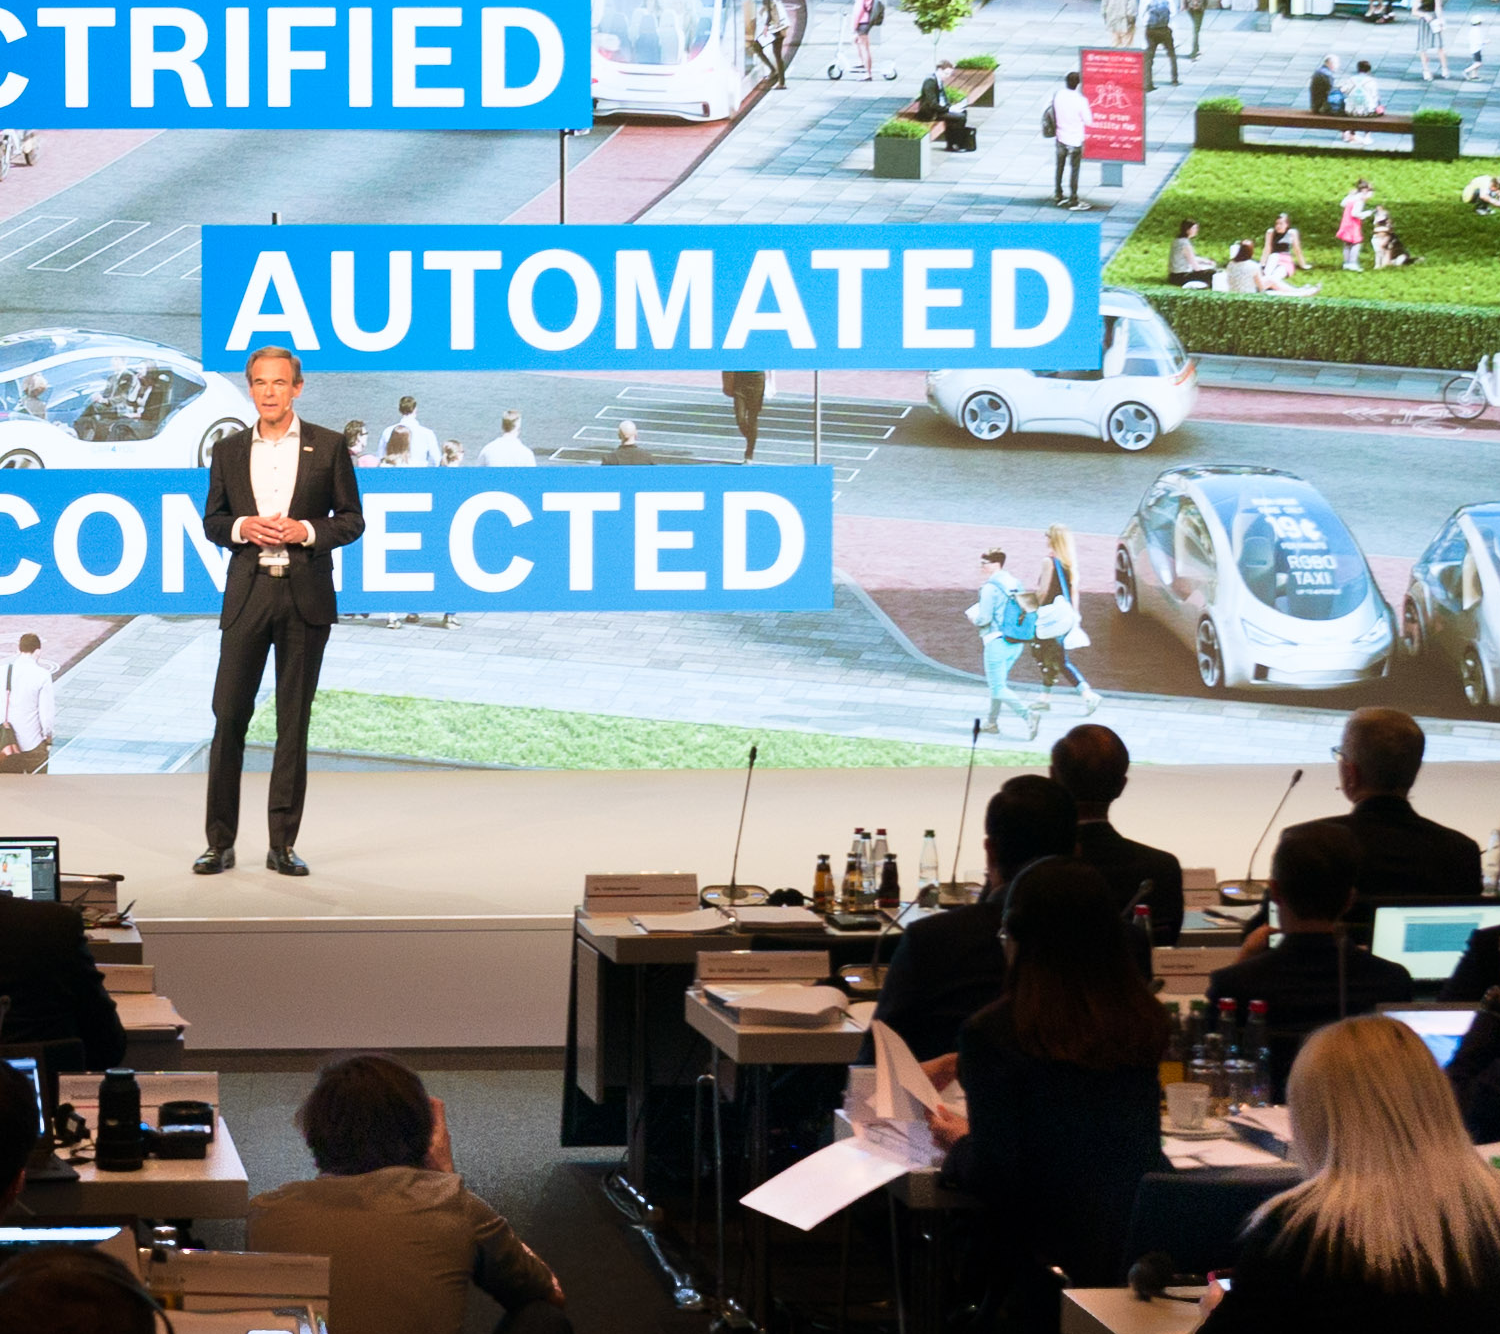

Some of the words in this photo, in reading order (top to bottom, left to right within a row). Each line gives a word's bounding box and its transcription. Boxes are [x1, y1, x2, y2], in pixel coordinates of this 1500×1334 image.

[225, 249, 1074, 351] AUTOMATED
[1287, 555, 1338, 570] ROBO
[1292, 571, 1333, 586] TAXI
